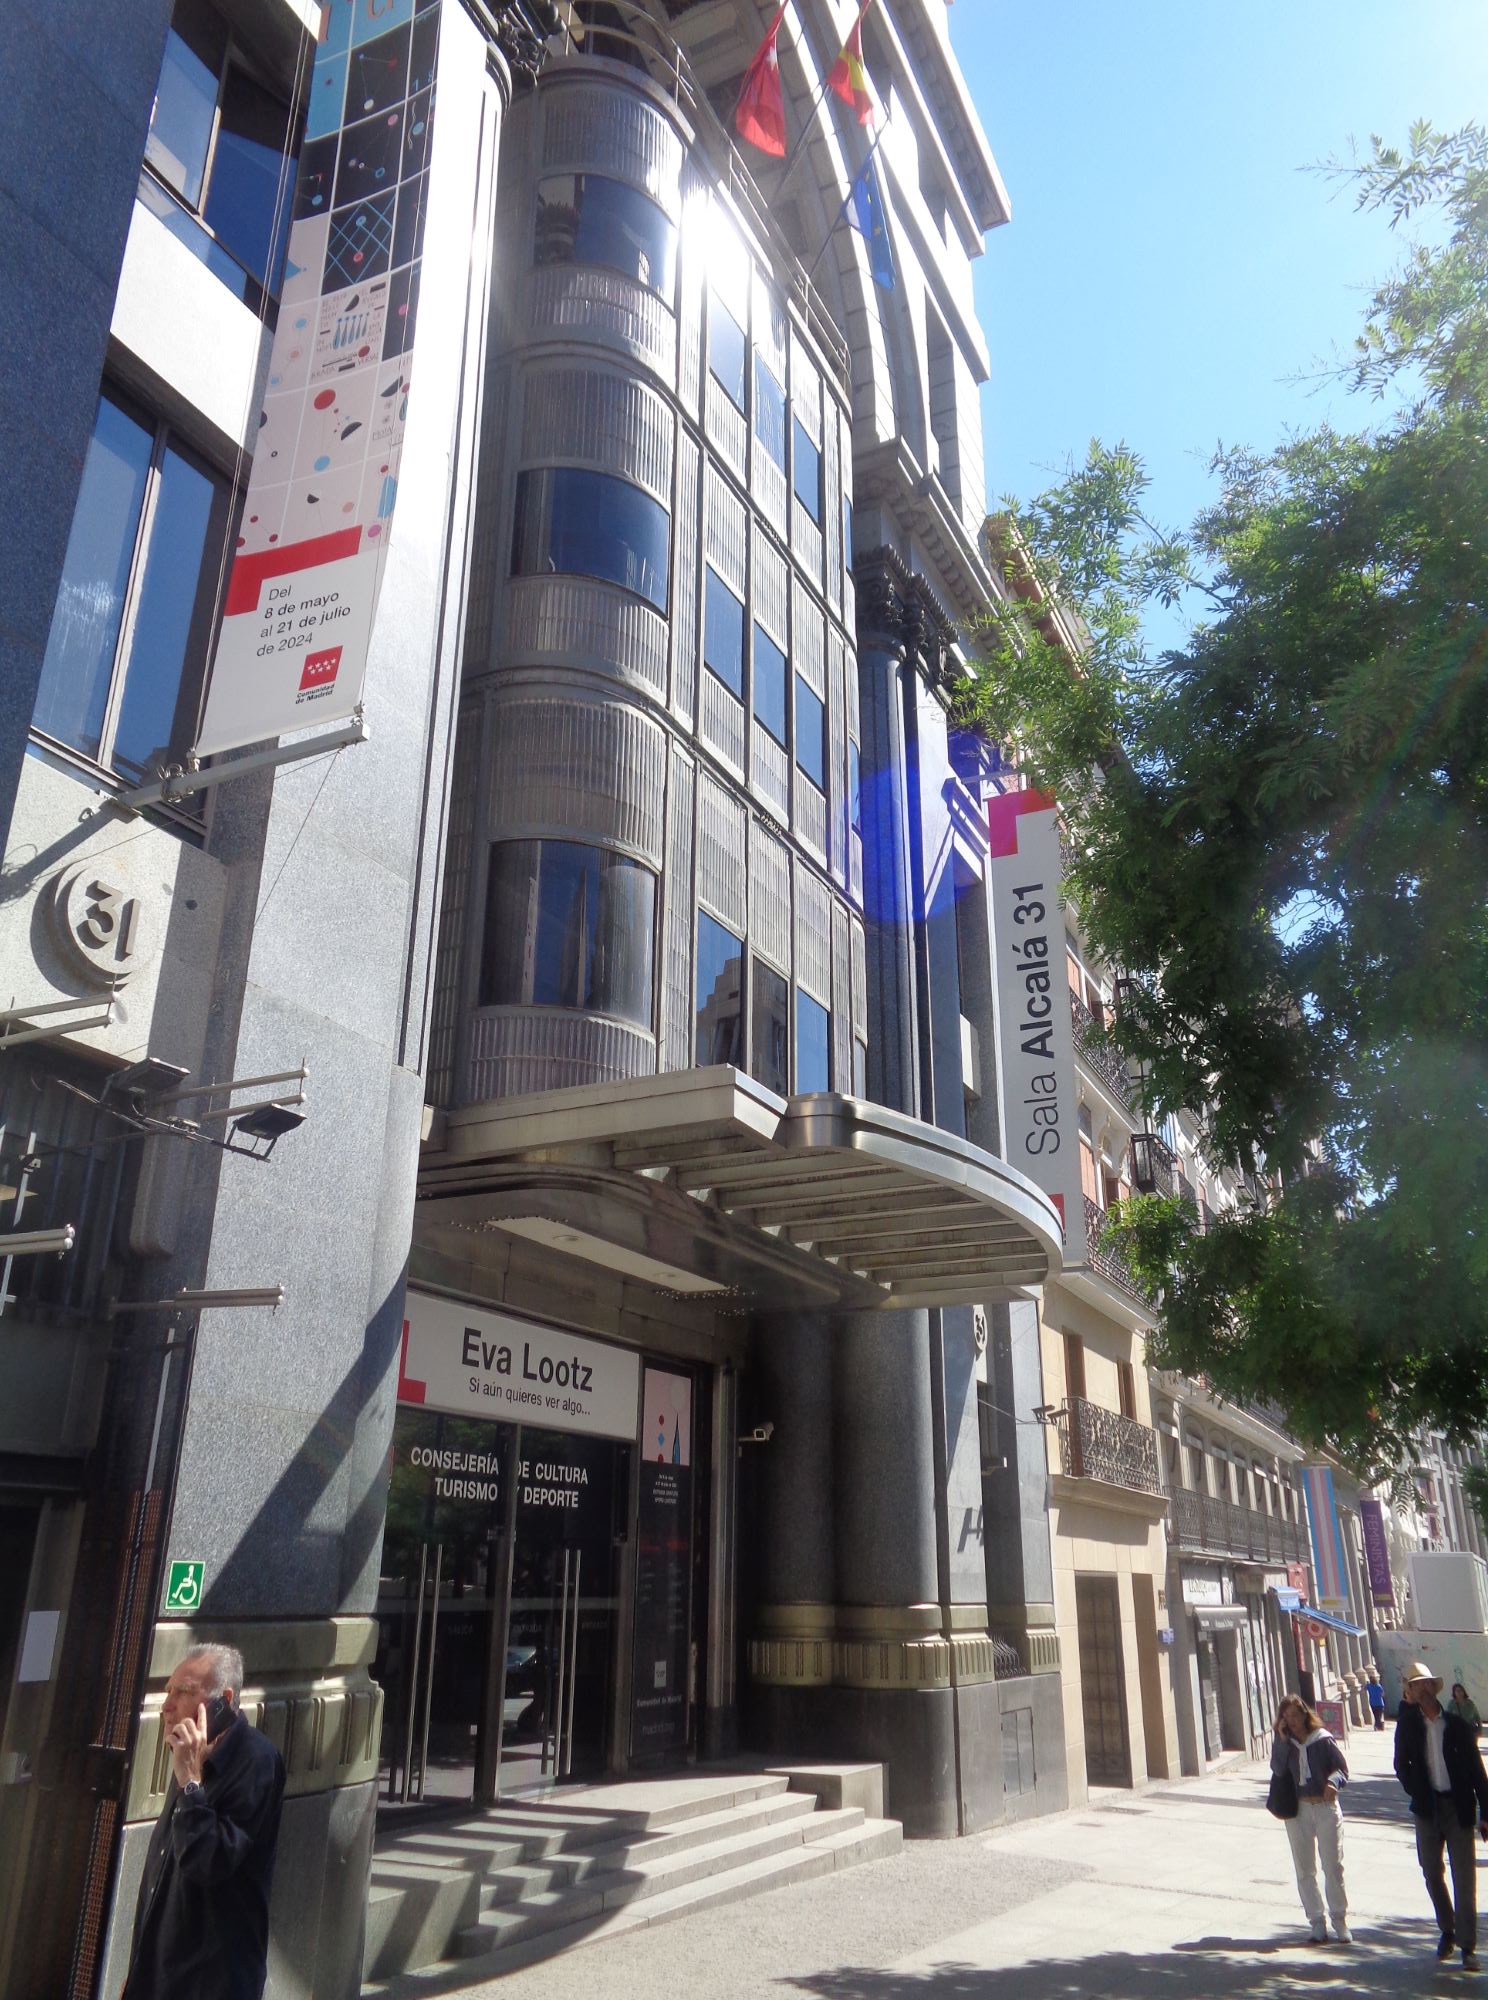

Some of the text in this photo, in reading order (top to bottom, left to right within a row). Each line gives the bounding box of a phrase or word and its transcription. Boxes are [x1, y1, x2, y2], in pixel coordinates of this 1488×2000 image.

[264, 592, 339, 619] 8 de mayo
[268, 585, 292, 601] Del
[260, 605, 351, 638] al 21 de julio
[256, 631, 313, 657] de 2024
[296, 683, 335, 698] Comunidad
[306, 690, 333, 702] Madrid
[82, 880, 141, 958] 31
[1012, 883, 1061, 1155] Sala Alcalá 31
[461, 1326, 593, 1392] Eva Lootz
[469, 1376, 591, 1416] Si aún quieres ver algo...
[410, 1446, 499, 1476] CONSEJERÍA
[535, 1462, 588, 1484] CULTURA
[435, 1477, 498, 1501] TURISMO
[523, 1486, 579, 1508] DEPORTE
[1366, 1514, 1386, 1584] FEMINISTAS
